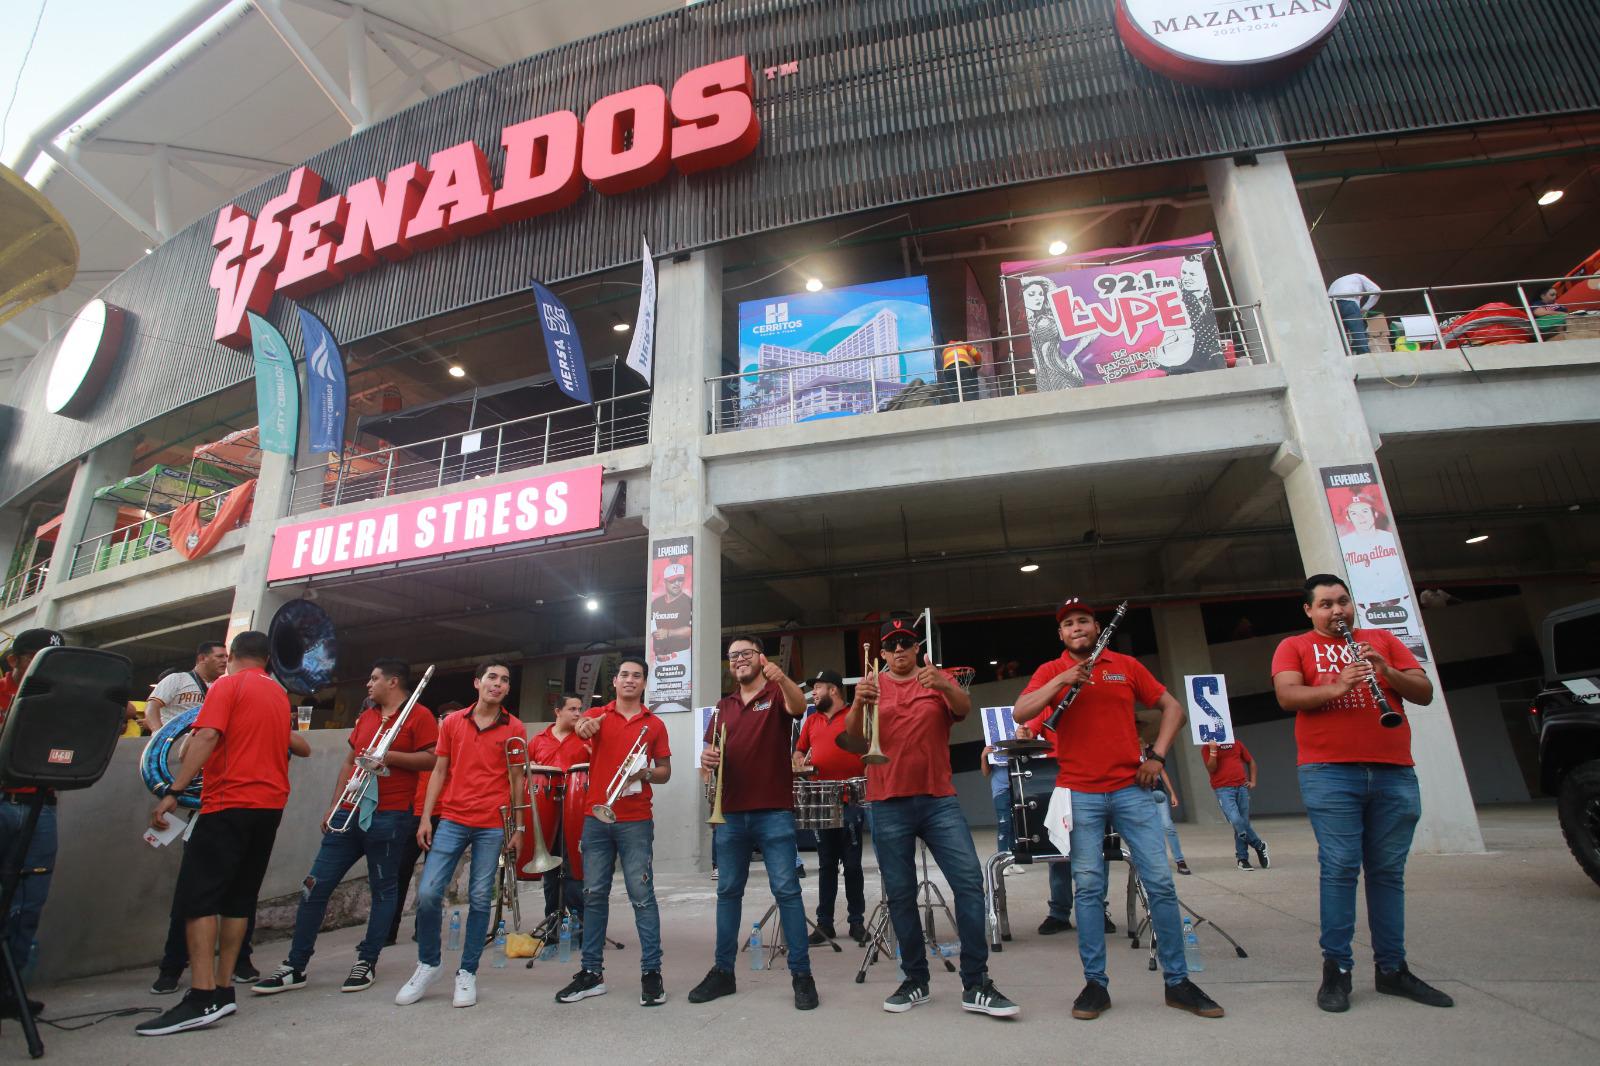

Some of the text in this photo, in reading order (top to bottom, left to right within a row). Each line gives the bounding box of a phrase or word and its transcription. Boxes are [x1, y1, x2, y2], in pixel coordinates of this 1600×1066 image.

[1212, 22, 1279, 37] 2021-2024
[208, 54, 761, 343] VENADOS
[1097, 272, 1175, 296] 92.1 FM
[752, 319, 803, 335] CERRITOS
[553, 339, 574, 392] HERSA
[1102, 367, 1129, 384] TODO
[1330, 472, 1371, 486] LEYENDAS
[291, 480, 569, 569] FUERA STRESS
[657, 544, 689, 557] LEYENDAS
[1367, 610, 1406, 620] Dick Hall
[1191, 676, 1227, 743] S
